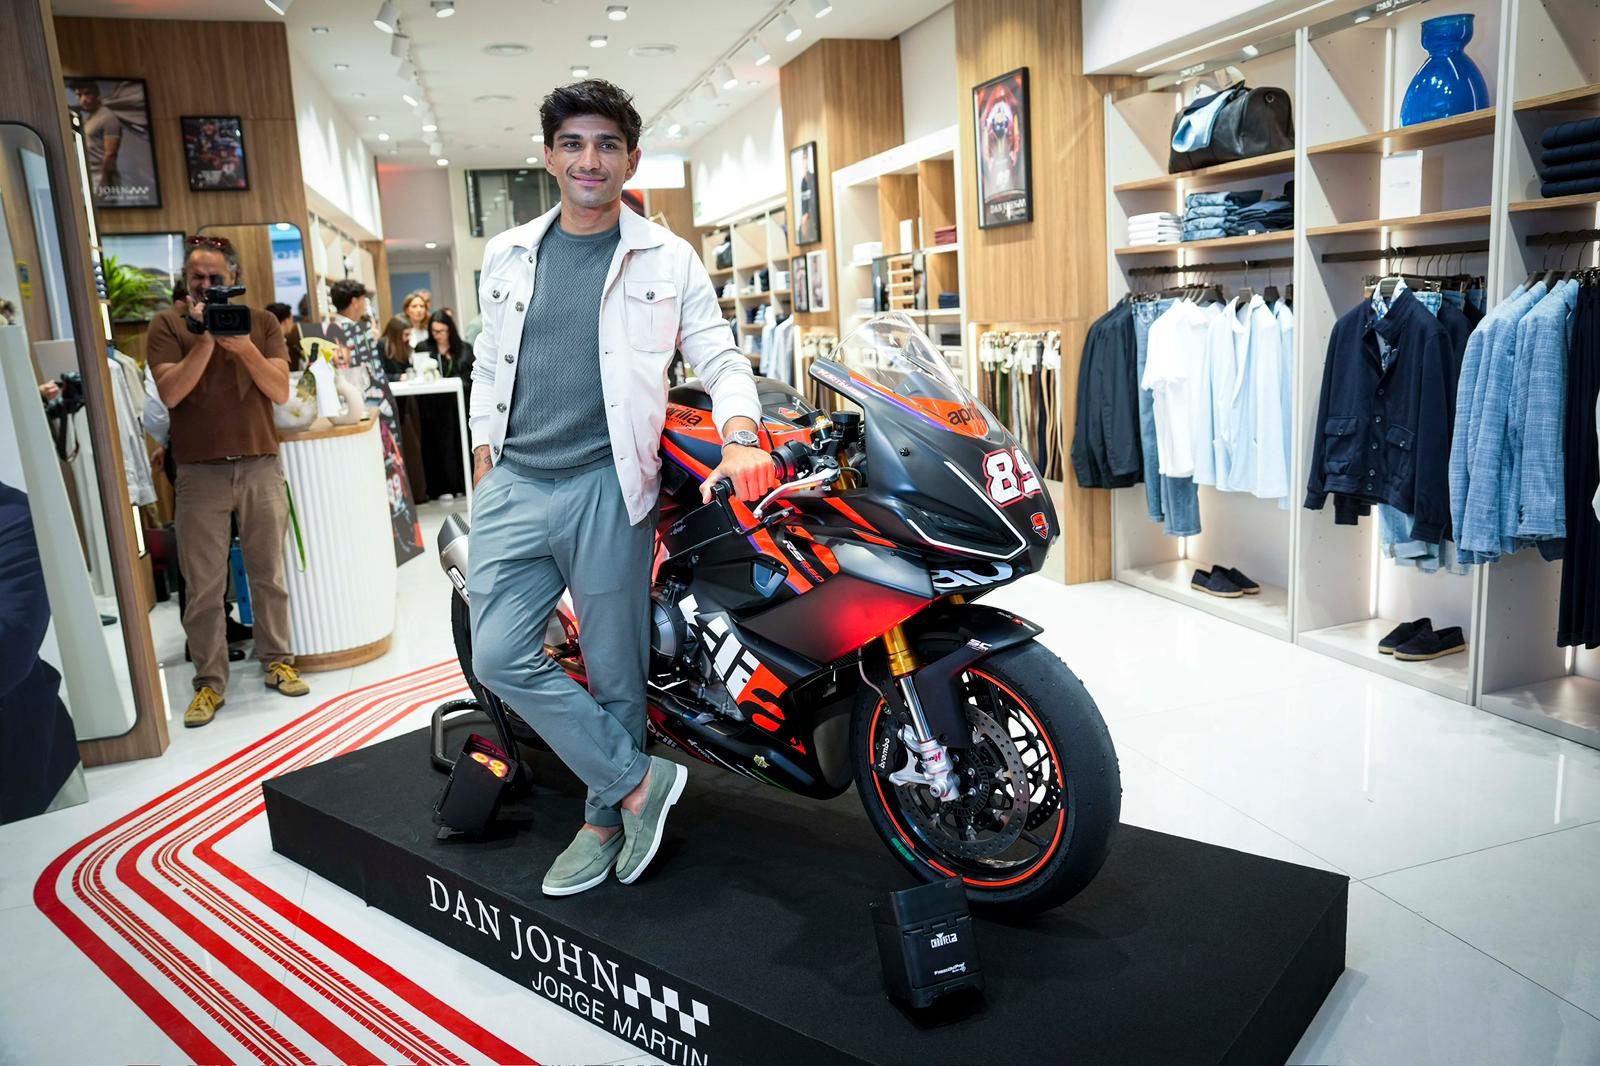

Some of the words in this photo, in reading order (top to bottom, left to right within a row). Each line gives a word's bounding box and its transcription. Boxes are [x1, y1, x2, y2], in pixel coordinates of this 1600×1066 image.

[878, 737, 890, 769] brembo
[426, 875, 501, 942] DAN
[510, 915, 620, 1000] JOHN
[532, 971, 605, 1024] JORGE
[613, 1009, 709, 1066] MARTIN
